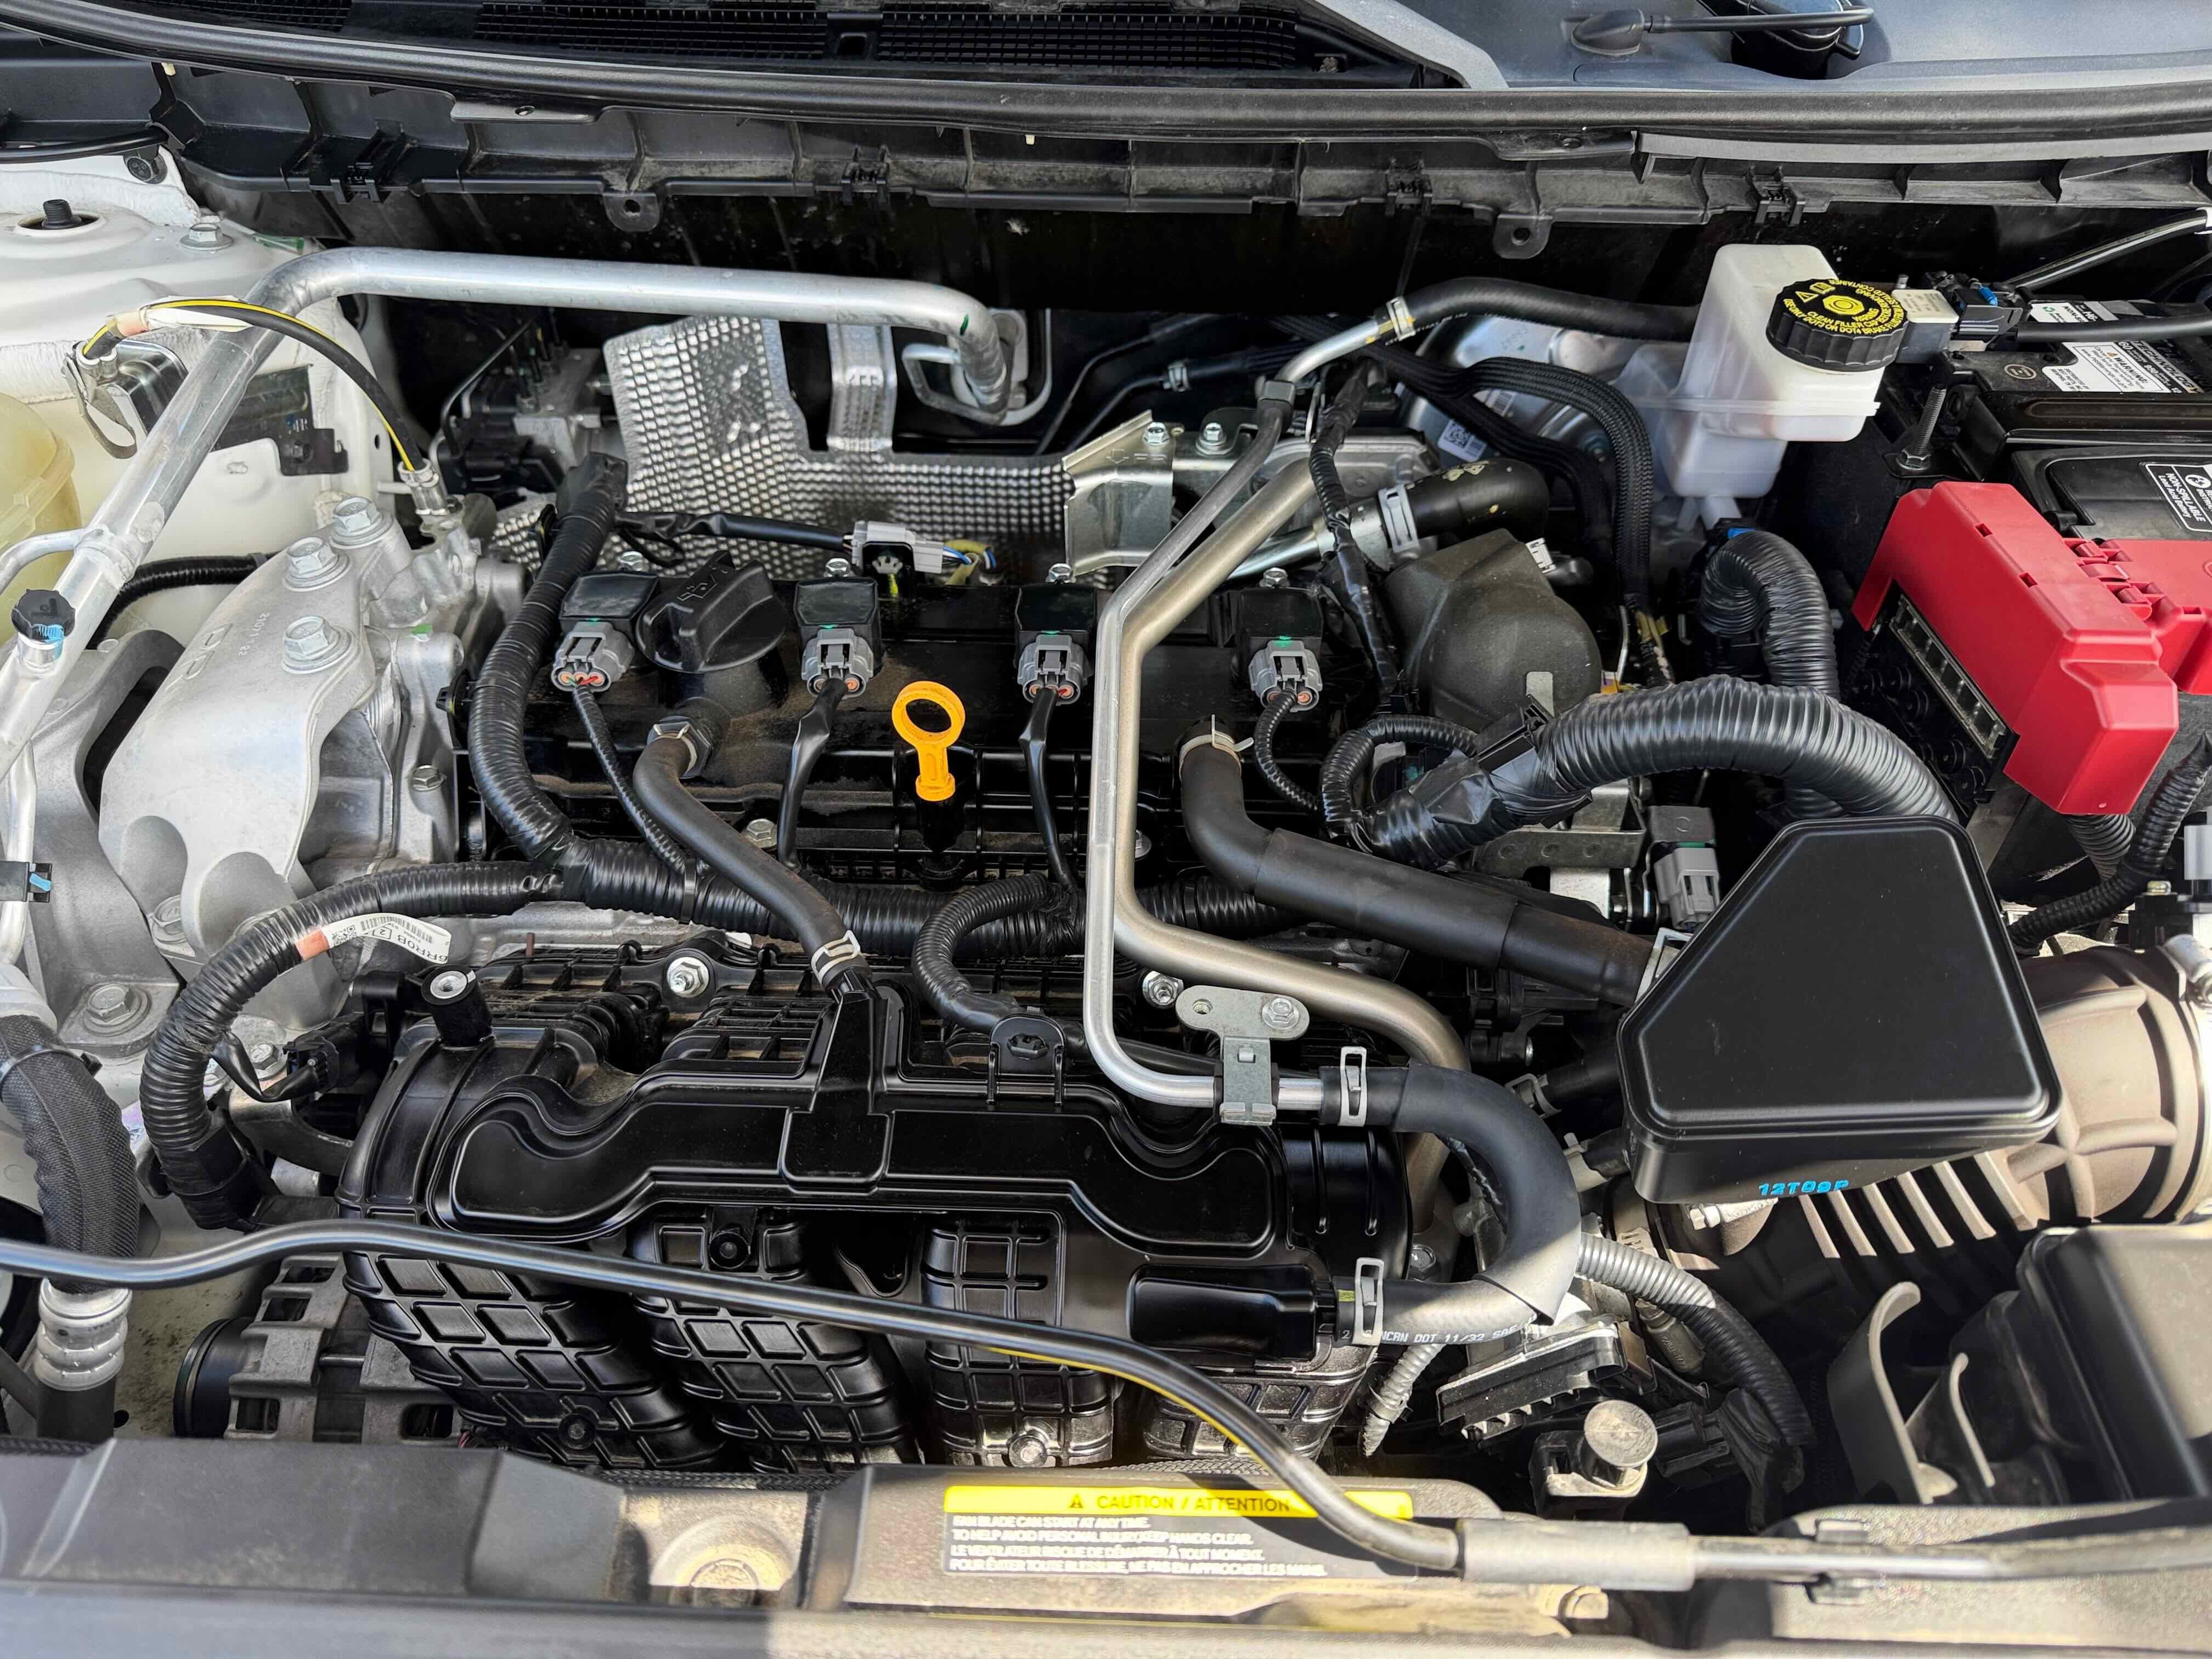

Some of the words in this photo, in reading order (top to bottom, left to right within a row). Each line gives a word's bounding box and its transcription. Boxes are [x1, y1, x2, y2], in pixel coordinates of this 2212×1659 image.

[1827, 279, 1875, 292] CONTAINER
[1803, 317, 1826, 328] DOT3
[1807, 311, 1834, 324] CLEAN
[1834, 320, 1865, 328] FILLER
[1861, 325, 1889, 334] BRAKE
[2118, 341, 2134, 350] 60
[2114, 357, 2148, 383] WARNING:
[2132, 341, 2204, 393] TECHNOLOGY
[2158, 475, 2172, 488] Lead
[2167, 488, 2181, 500] Acid
[2174, 500, 2192, 518] Battery
[2165, 473, 2205, 522] NON-SPILLABLE
[1444, 1333, 1485, 1343] 11/32
[1097, 1495, 1173, 1509] CAUTION
[1195, 1497, 1290, 1512] ATTENTION
[977, 1516, 1016, 1527] BLADE
[1016, 1516, 1042, 1527] CAN
[1043, 1516, 1079, 1528] START
[1079, 1517, 1095, 1528] AT
[952, 1529, 969, 1541] TO
[970, 1530, 1002, 1541] HELP
[1002, 1530, 1037, 1542] AVOID
[1038, 1531, 1098, 1543] PERSONAL
[1212, 1533, 1254, 1545] CLEAR.
[951, 1545, 968, 1556] LE
[1179, 1548, 1211, 1560] TOUT
[1211, 1548, 1265, 1560] MOMENT.
[950, 1559, 985, 1571] POUR
[1263, 1564, 1287, 1576] LES
